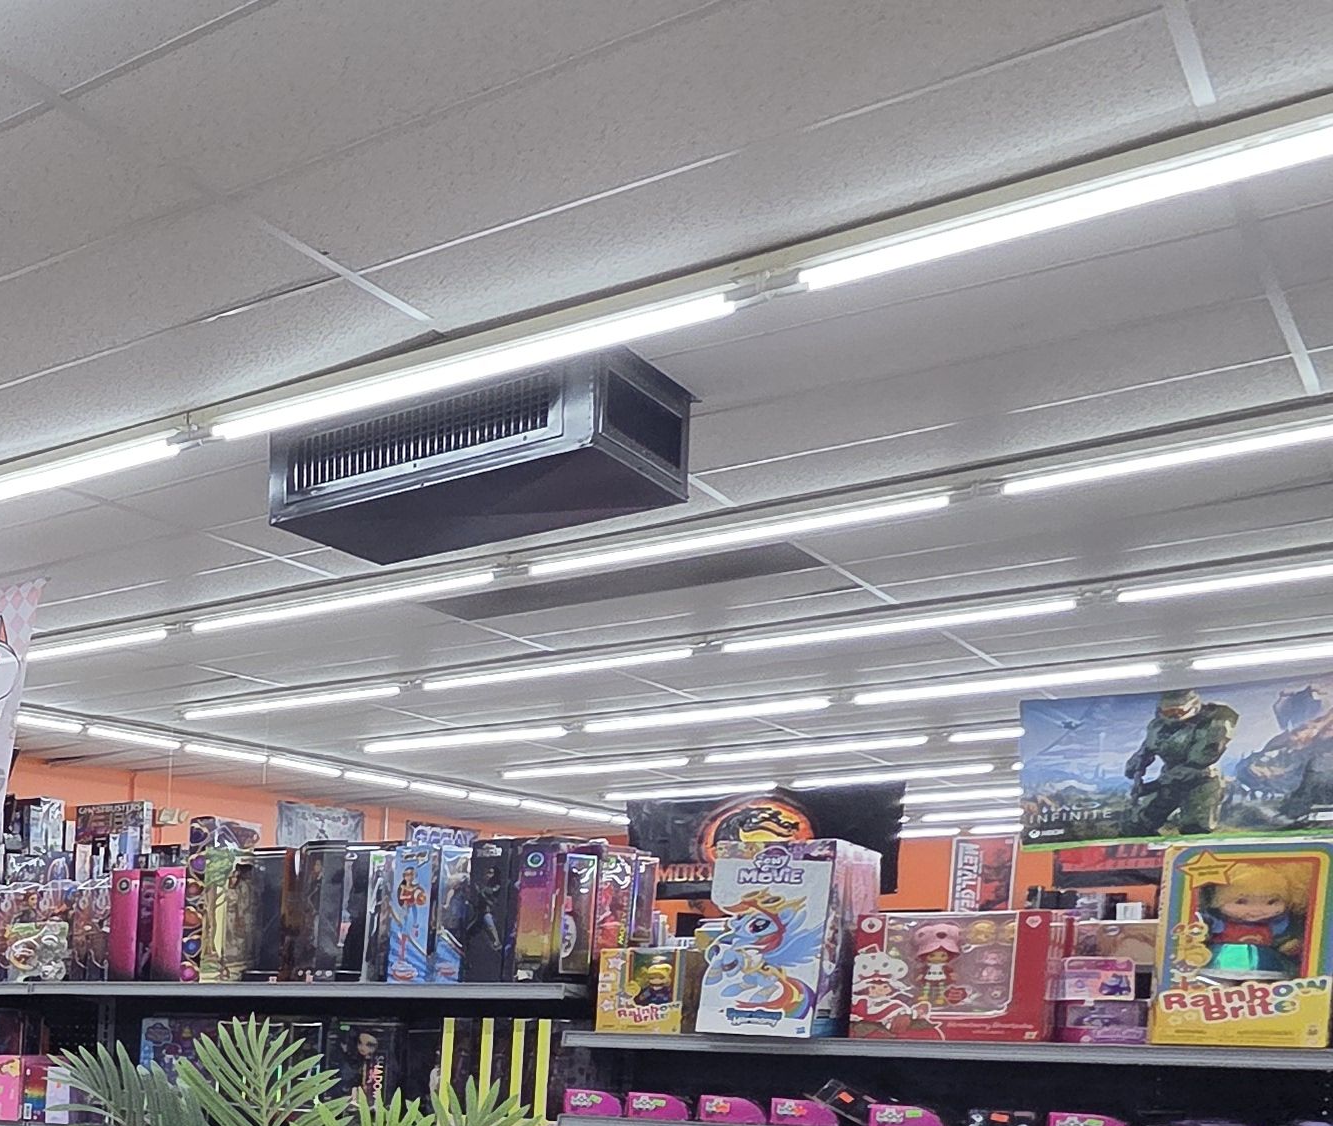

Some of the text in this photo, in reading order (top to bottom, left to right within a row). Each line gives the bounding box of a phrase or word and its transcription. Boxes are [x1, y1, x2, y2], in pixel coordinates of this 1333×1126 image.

[1029, 809, 1112, 824] INFINITE
[1162, 979, 1328, 1011] Rainbow
[617, 1003, 680, 1018] Rainbow
[1204, 999, 1298, 1022] Brite
